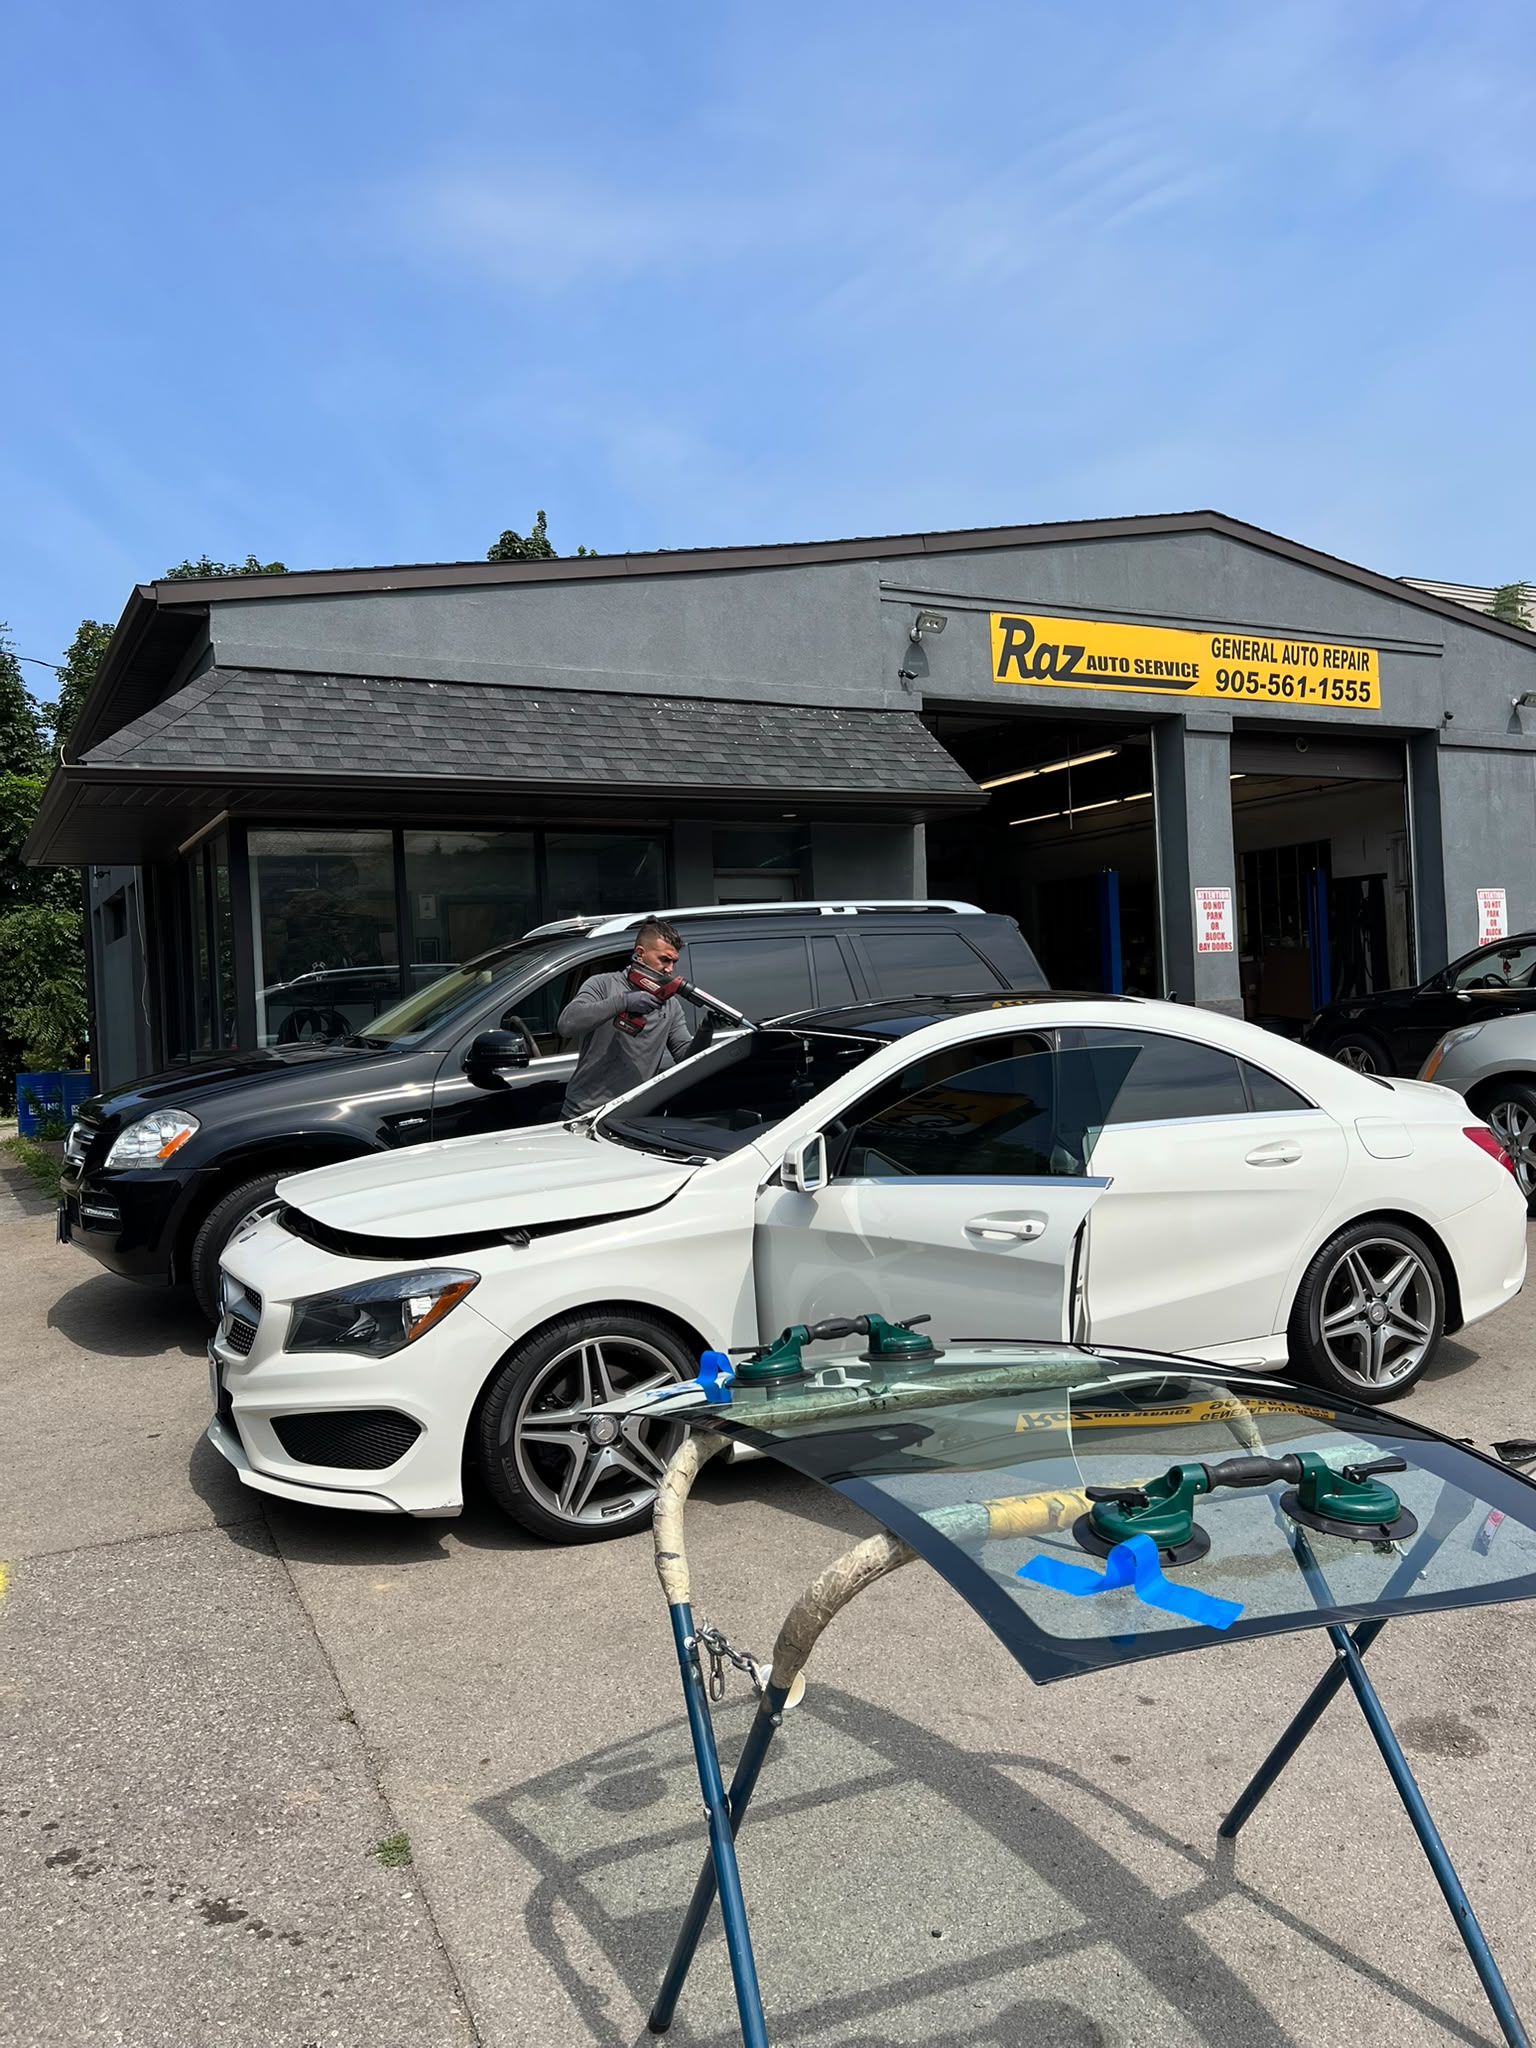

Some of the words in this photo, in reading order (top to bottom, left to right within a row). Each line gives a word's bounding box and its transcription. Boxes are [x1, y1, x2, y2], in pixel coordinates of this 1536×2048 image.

[997, 617, 1086, 680] Raz
[1086, 655, 1130, 674] AUTO
[1134, 658, 1200, 679] SERVICE
[1211, 637, 1278, 664] GENERAL
[1282, 644, 1319, 667] AUTO
[1323, 648, 1370, 672] REPAIR
[1215, 668, 1371, 703] 905-561-1555
[1203, 902, 1212, 910] DO
[1213, 901, 1225, 910] NOT
[1206, 911, 1223, 920] PARK
[1211, 922, 1219, 930] OR
[1205, 932, 1226, 941] BLOCK
[1199, 943, 1210, 951] BAY
[1211, 942, 1233, 951] DOORS
